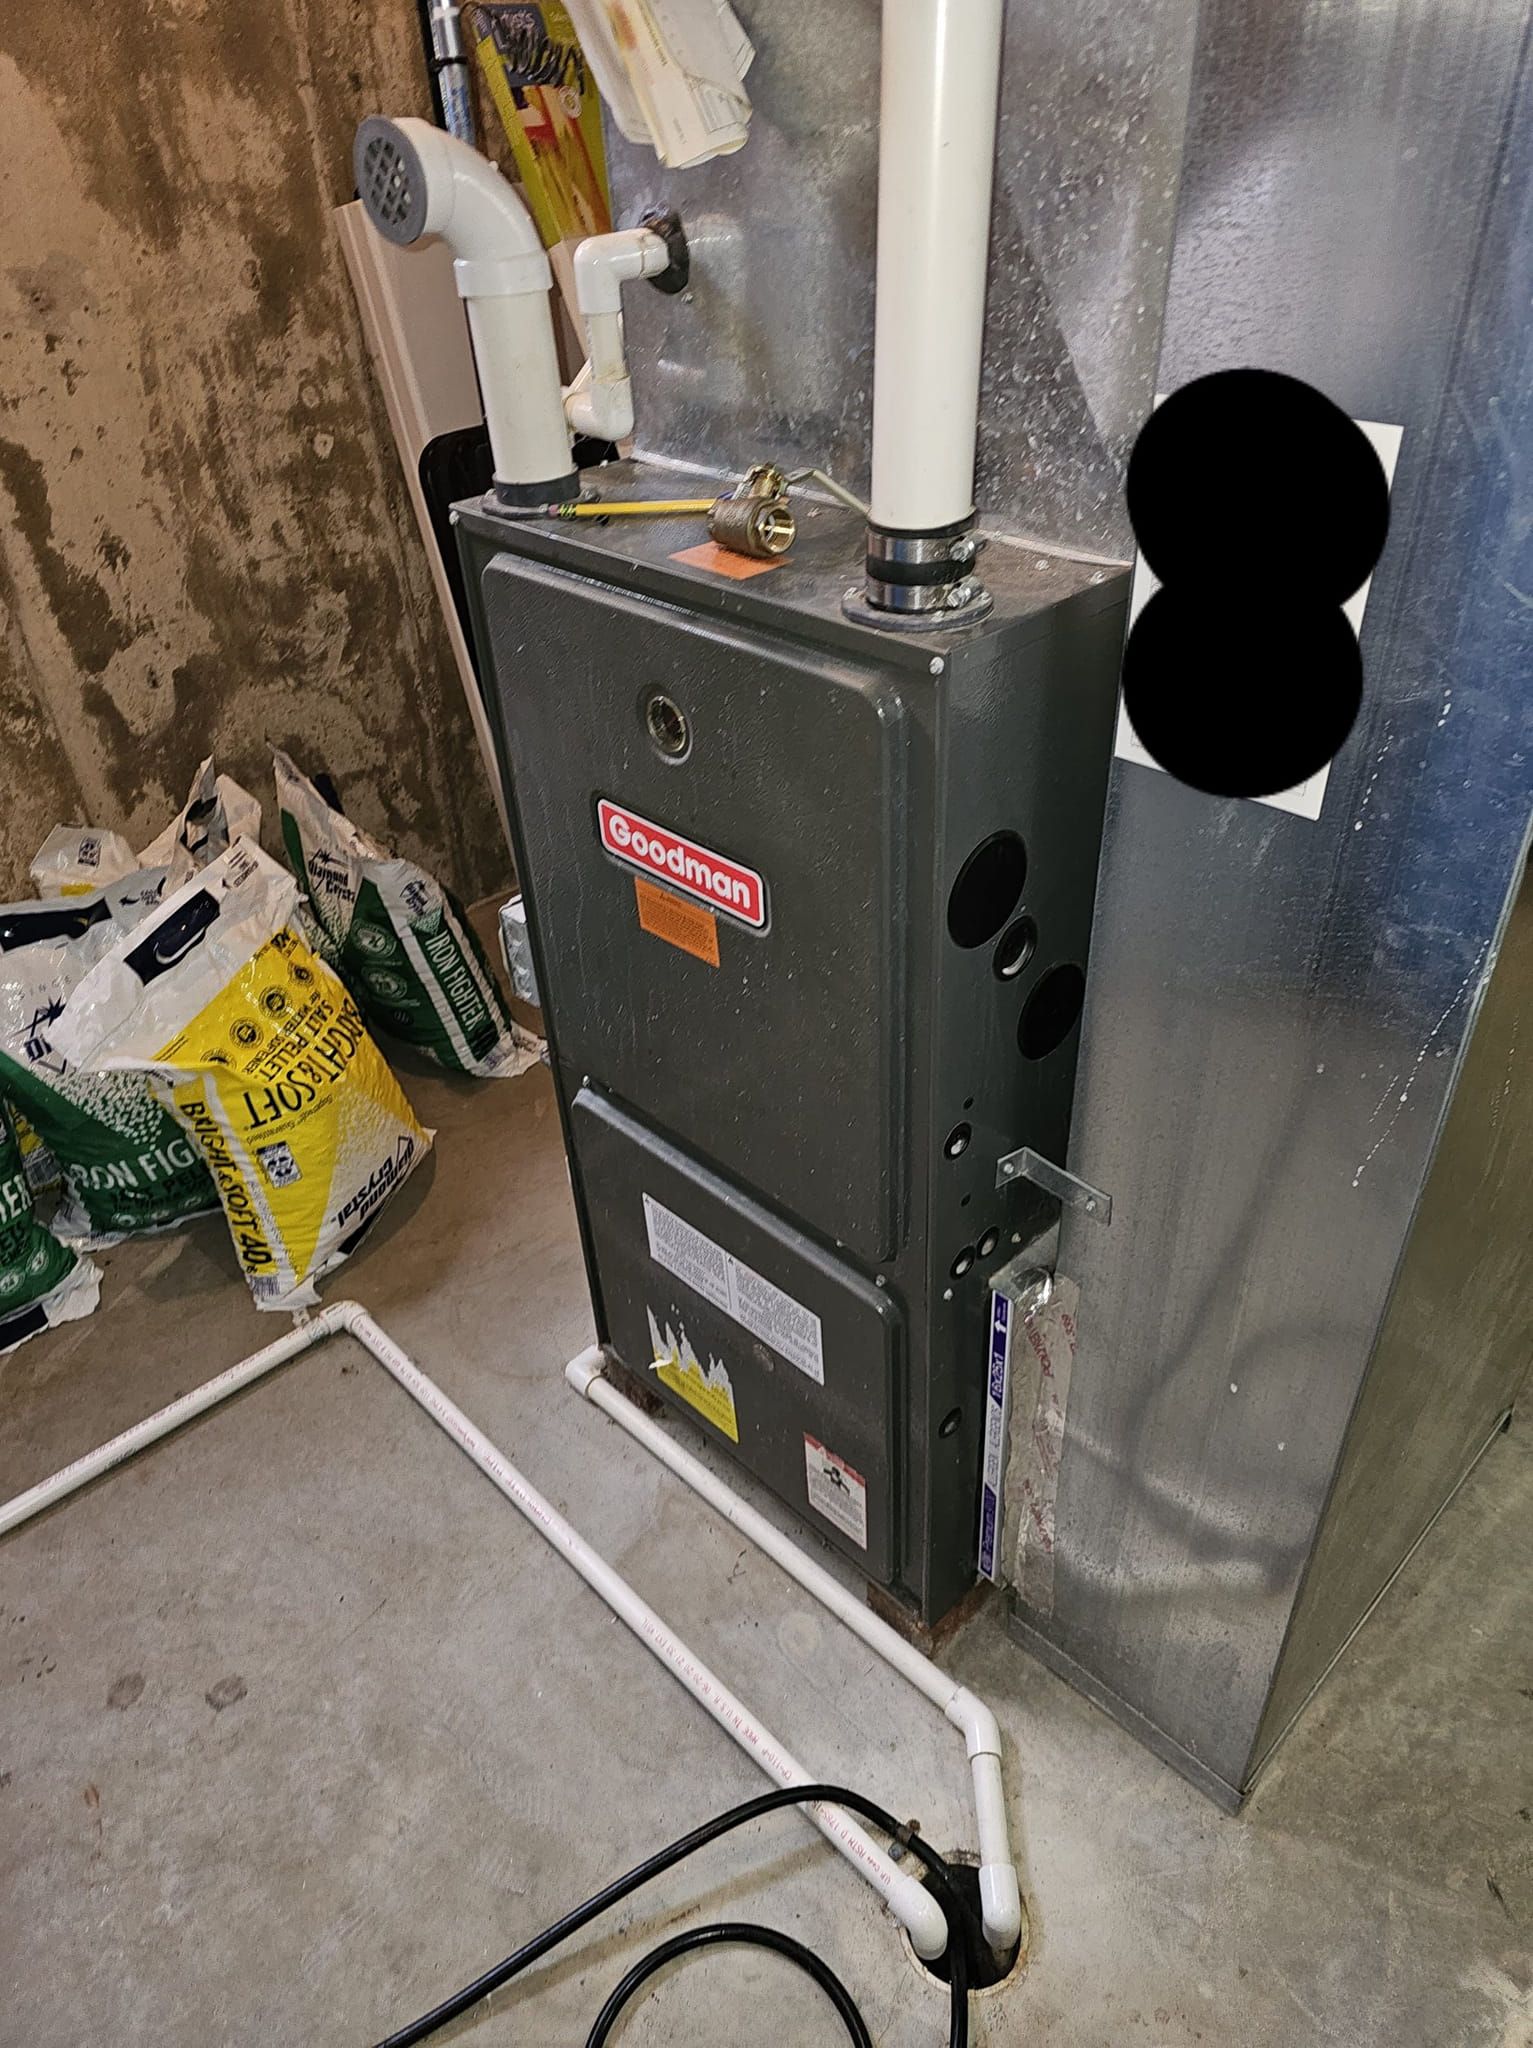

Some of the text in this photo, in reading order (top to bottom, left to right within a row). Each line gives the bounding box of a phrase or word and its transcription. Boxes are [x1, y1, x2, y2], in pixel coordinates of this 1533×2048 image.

[609, 813, 751, 909] Goodman
[305, 1000, 334, 1037] SALT
[425, 931, 460, 974] IRON
[447, 968, 487, 1033] FIGHTER
